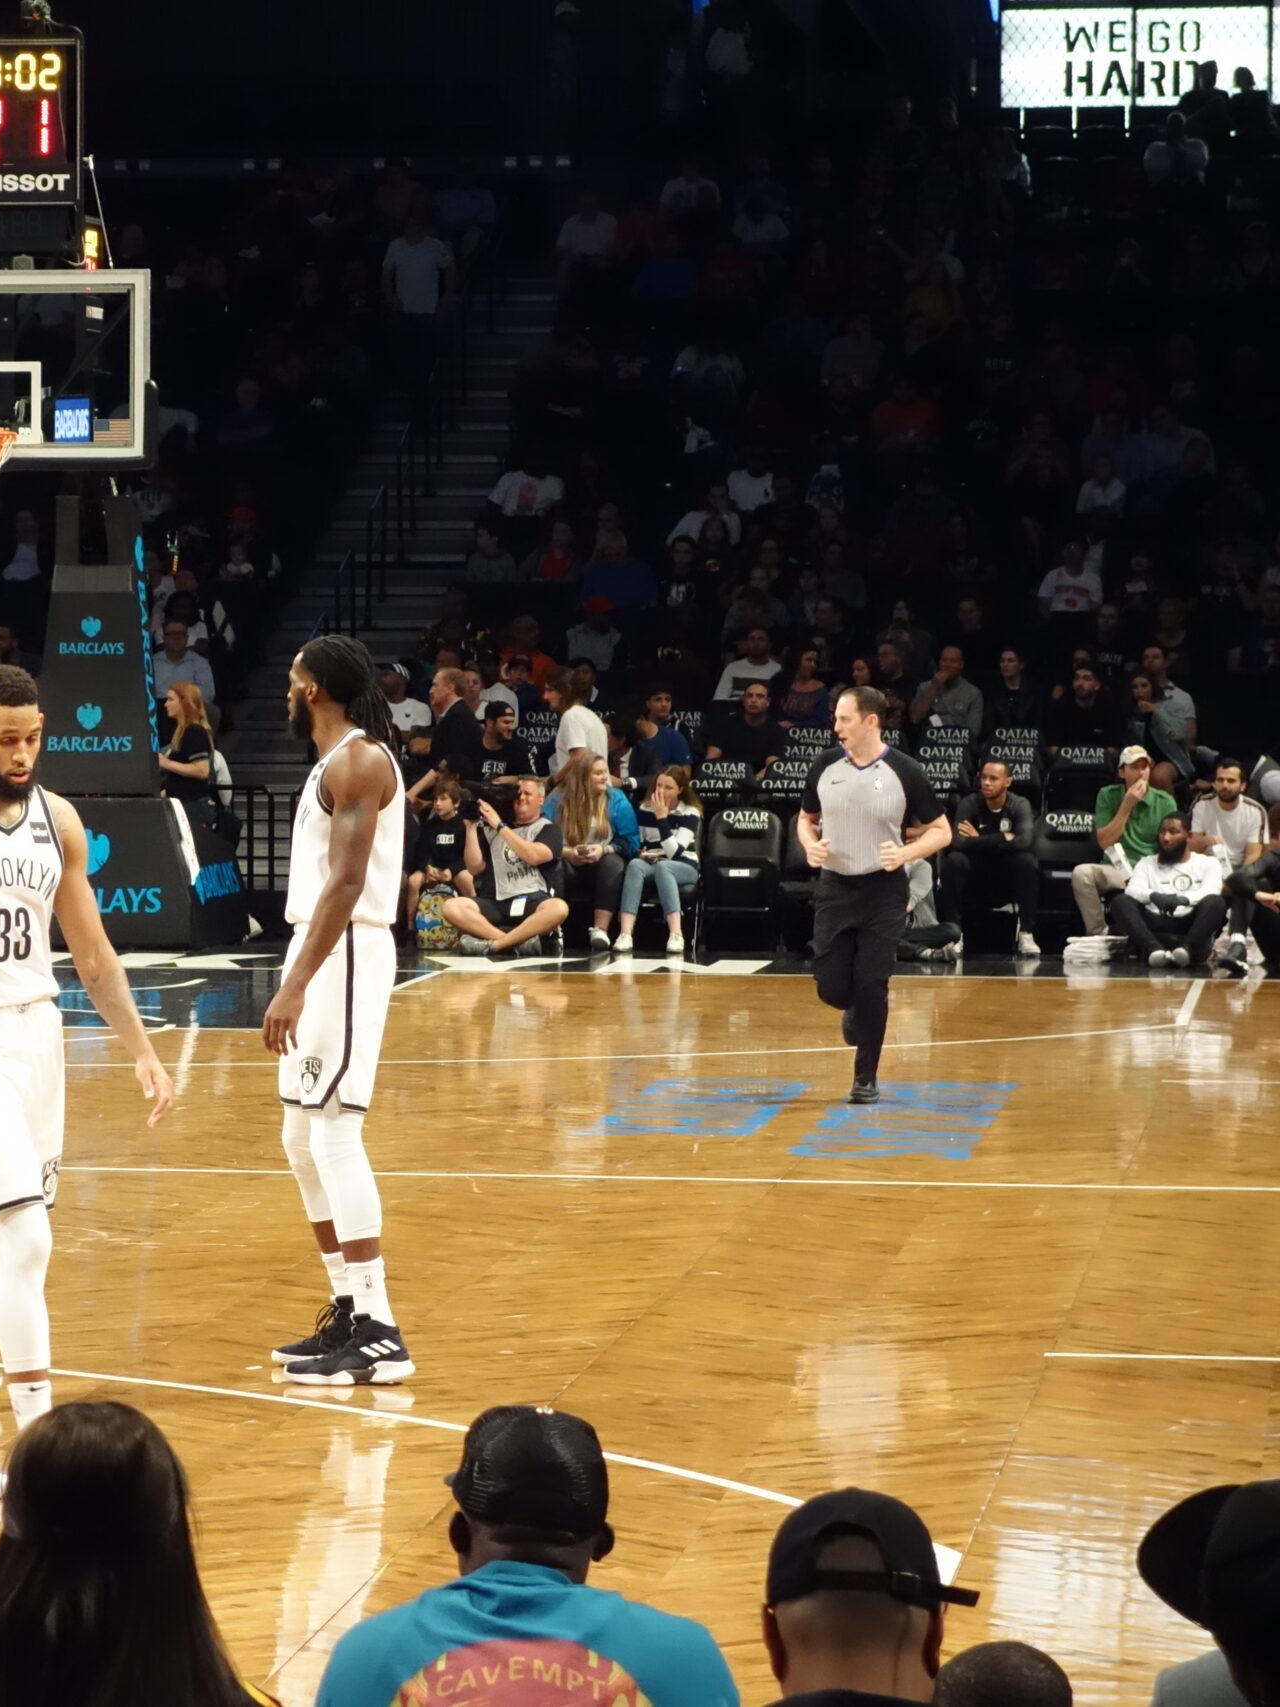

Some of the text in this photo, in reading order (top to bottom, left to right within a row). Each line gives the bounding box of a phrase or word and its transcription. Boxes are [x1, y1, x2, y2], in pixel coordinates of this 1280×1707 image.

[1065, 21, 1201, 52] WE GO
[58, 642, 125, 655] BARCLAYS
[136, 579, 161, 753] BARCLAYS
[526, 711, 558, 723] QATA
[671, 711, 702, 721] ATAR
[789, 727, 832, 740] QATAR
[926, 728, 970, 740] QATAR
[995, 728, 1039, 740] QATAR
[47, 736, 133, 752] BARCLAYS
[920, 746, 964, 759] QATAR
[990, 746, 1035, 758] QATAR
[1060, 746, 1105, 759] QATAR
[701, 762, 747, 775] QATAR
[773, 761, 813, 774] QATA
[722, 809, 770, 824] QATAR
[1045, 812, 1094, 827] QATAR
[733, 821, 770, 830] AIRWAYS
[1056, 824, 1094, 833] AIRWAYS
[97, 887, 162, 914] LAYS
[435, 1656, 607, 1701] CAVEMPT
